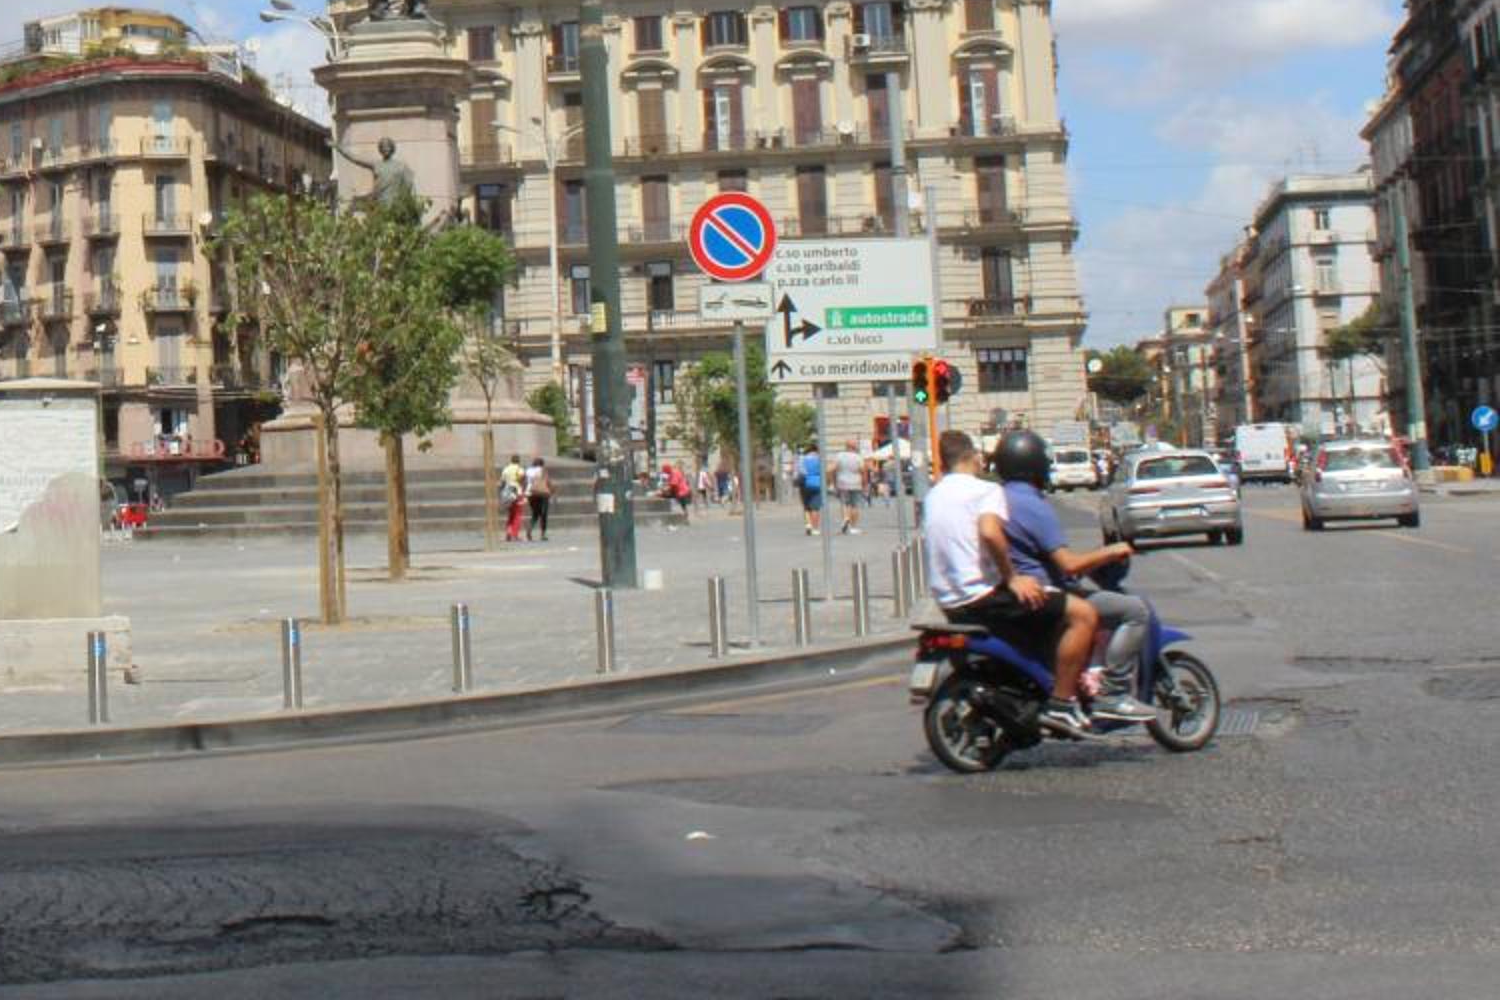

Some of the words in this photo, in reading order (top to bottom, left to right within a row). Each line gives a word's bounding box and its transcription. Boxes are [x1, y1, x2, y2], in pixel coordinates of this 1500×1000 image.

[803, 246, 858, 257] umberto
[803, 260, 861, 274] garibaldi
[812, 274, 844, 285] carlo
[853, 333, 883, 344] lucci
[799, 363, 826, 375] c.so
[827, 360, 909, 375] meridionale
